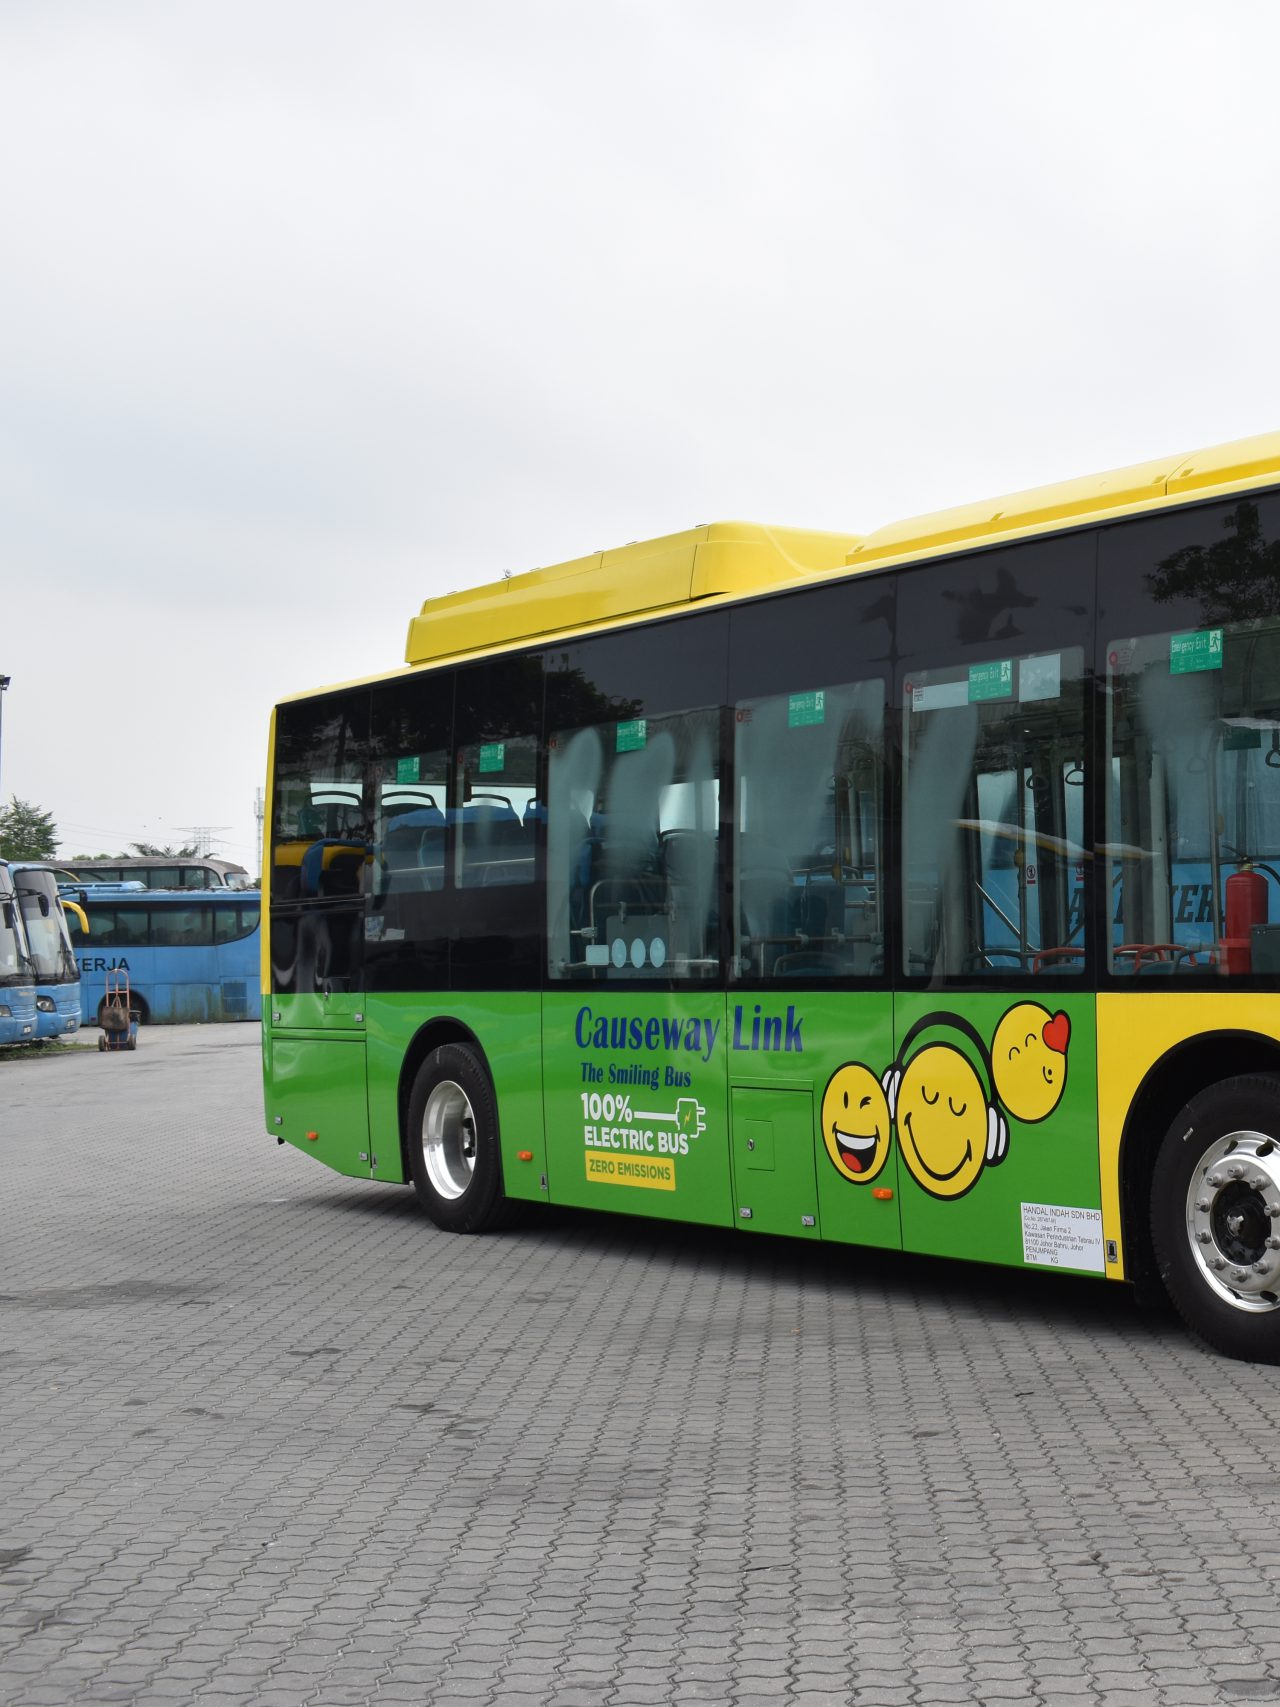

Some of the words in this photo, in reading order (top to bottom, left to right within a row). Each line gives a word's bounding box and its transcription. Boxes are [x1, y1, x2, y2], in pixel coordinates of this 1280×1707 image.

[575, 1006, 720, 1063] Causeway
[732, 1005, 804, 1052] Link
[581, 1062, 603, 1083] The
[608, 1063, 659, 1090] Smiling
[665, 1065, 691, 1088] Bus
[581, 1092, 633, 1123] 100%
[584, 1125, 654, 1152] ELECTRIC
[658, 1131, 689, 1155] BUS
[589, 1158, 615, 1175] ZERO
[618, 1162, 671, 1181] EMISSIONS
[1024, 1206, 1048, 1216] HANDAL
[1050, 1209, 1069, 1218] INDAH
[1071, 1210, 1085, 1219] SDN
[1087, 1212, 1100, 1221] BHD
[1050, 1256, 1059, 1264] KG
